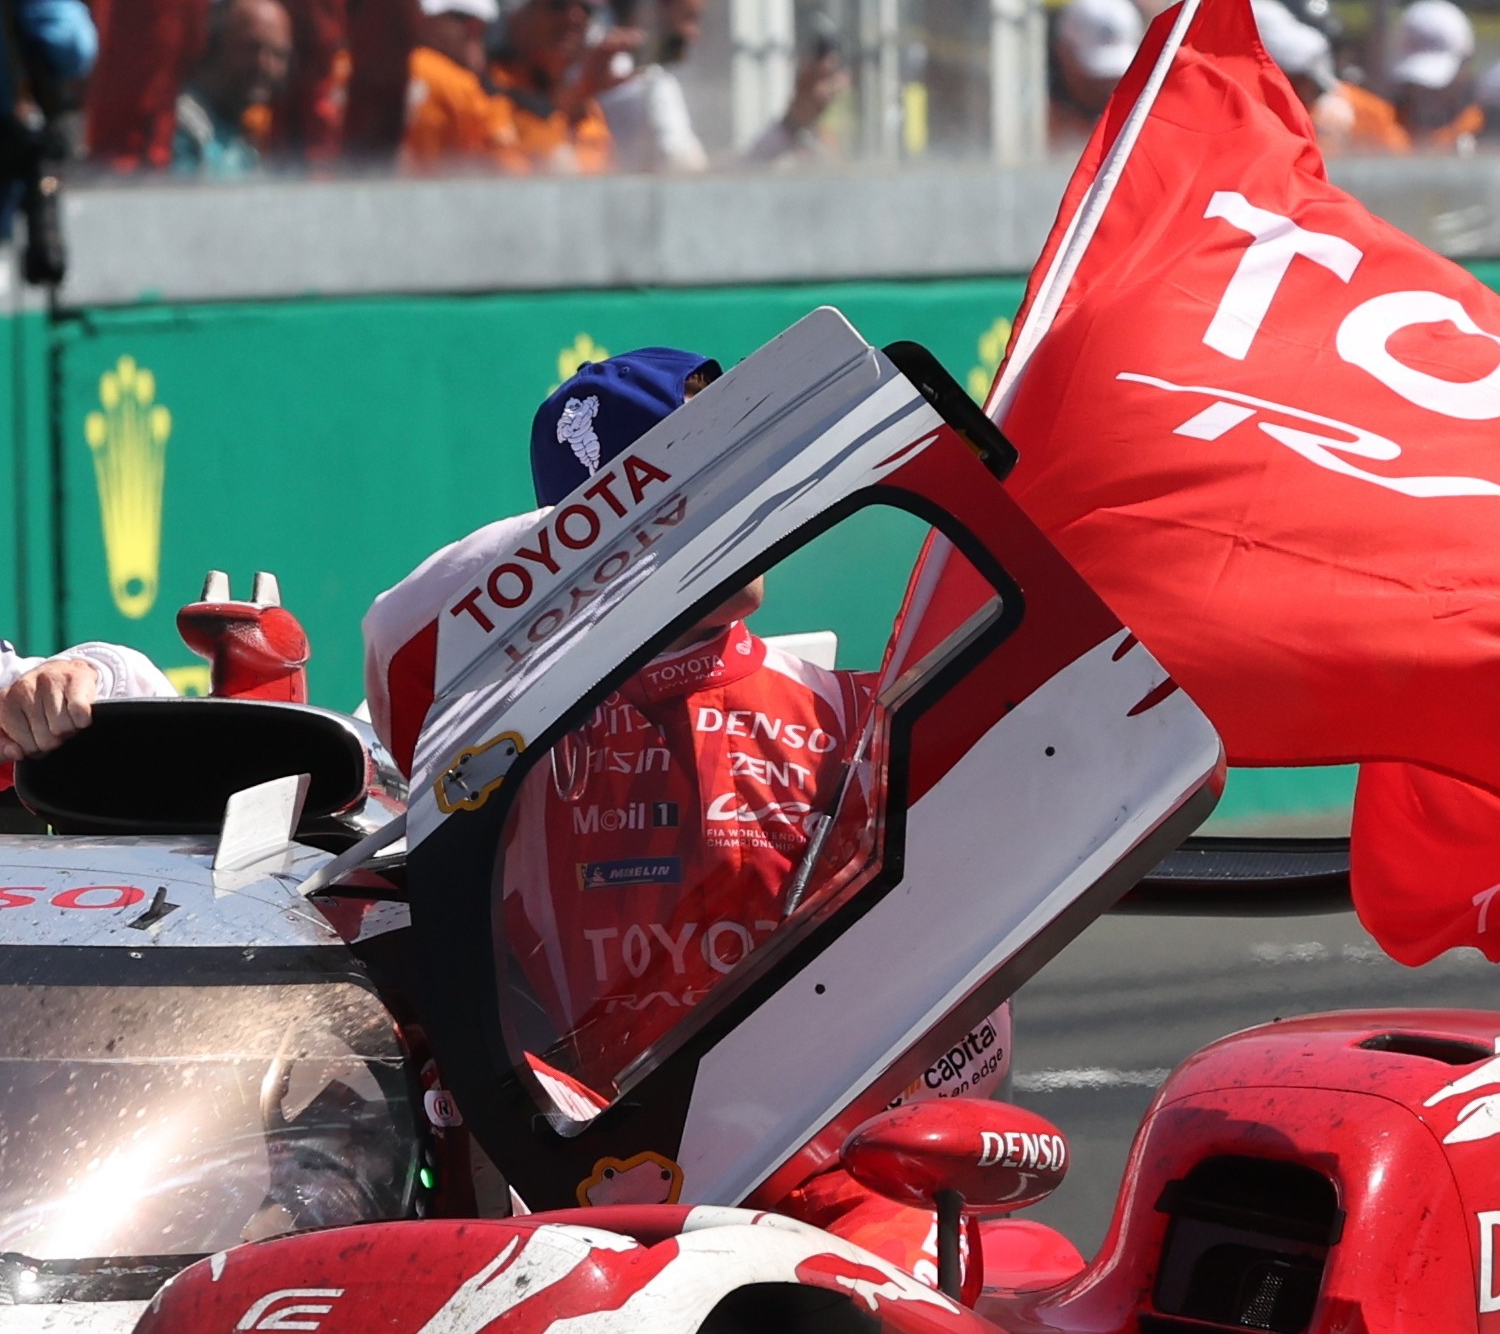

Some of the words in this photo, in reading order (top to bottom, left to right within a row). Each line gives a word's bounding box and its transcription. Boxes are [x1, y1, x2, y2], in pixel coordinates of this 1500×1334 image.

[450, 454, 671, 635] TOYOTA
[647, 654, 726, 685] TOYOTA
[696, 707, 838, 754] DENSO
[726, 751, 811, 790] ZENT
[924, 1017, 998, 1090] capital
[972, 1047, 1004, 1084] edge
[978, 1131, 1067, 1172] DENSO
